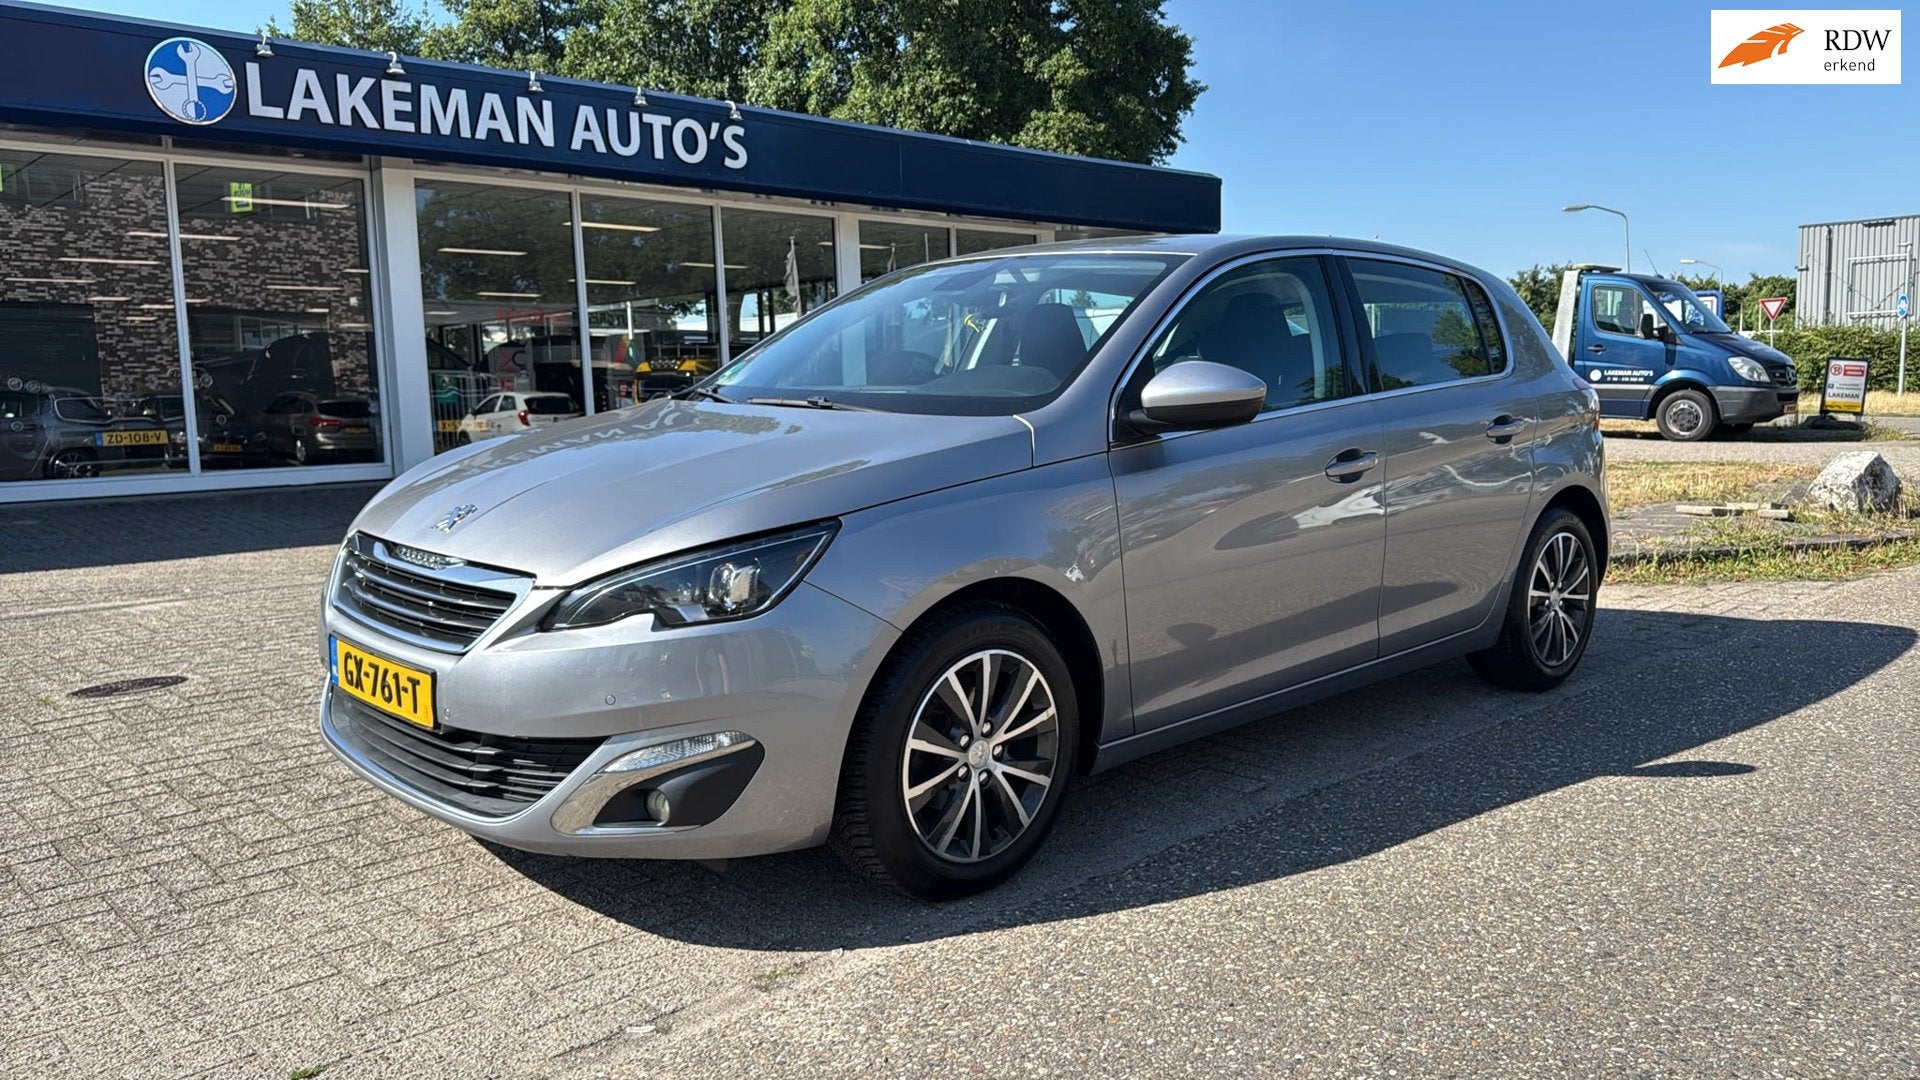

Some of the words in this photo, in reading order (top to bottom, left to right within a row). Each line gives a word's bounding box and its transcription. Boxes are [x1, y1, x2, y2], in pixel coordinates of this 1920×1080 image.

[246, 62, 555, 148] LAKEMAN
[570, 105, 748, 169] AUTO'S
[106, 431, 162, 444] ZD-108-V
[343, 651, 421, 715] GX-761-T
